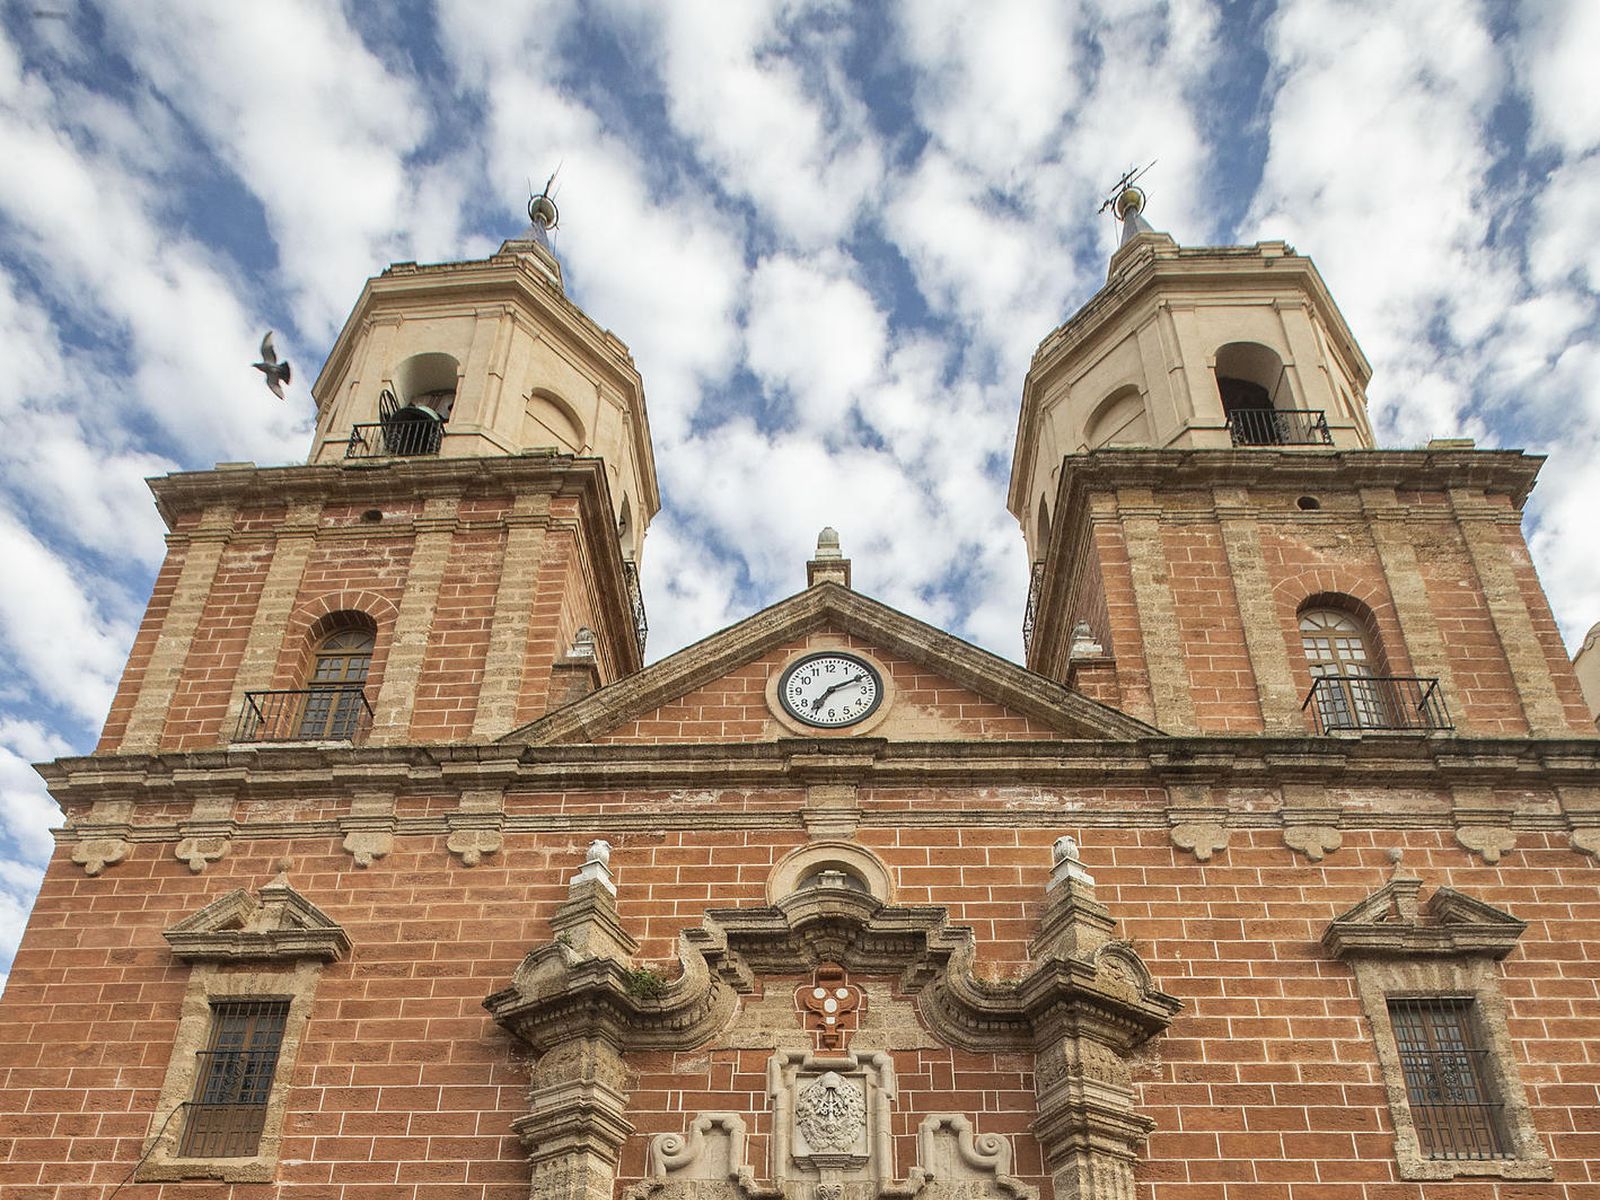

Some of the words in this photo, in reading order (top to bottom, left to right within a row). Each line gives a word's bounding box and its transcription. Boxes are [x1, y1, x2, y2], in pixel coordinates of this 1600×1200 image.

[811, 668, 820, 676] 11
[825, 664, 836, 673] 12
[843, 667, 849, 675] 1
[800, 676, 811, 685] 10
[795, 687, 802, 696] 9
[860, 686, 868, 695] 3
[800, 698, 808, 707] 8
[855, 698, 862, 706] 4
[828, 709, 835, 718] 6
[843, 706, 850, 715] 5
